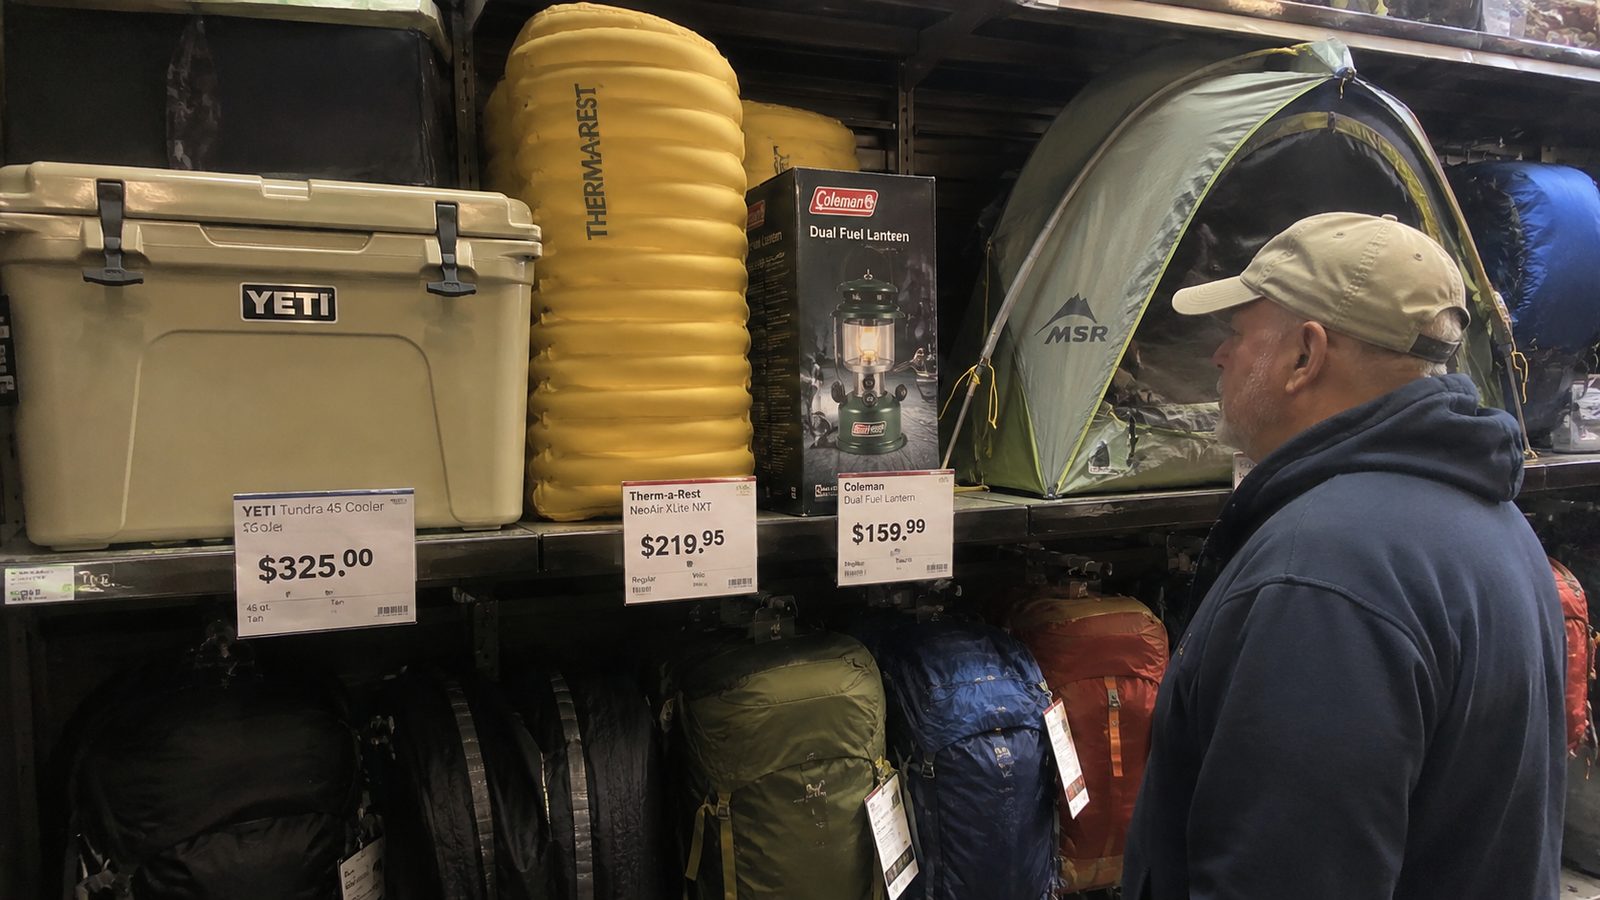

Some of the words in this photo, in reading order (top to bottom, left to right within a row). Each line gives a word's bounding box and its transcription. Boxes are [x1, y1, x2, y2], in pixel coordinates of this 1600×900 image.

[816, 190, 863, 208] Coleman
[809, 225, 837, 239] Dual
[839, 227, 864, 240] Fuel
[246, 290, 329, 316] YETI
[1044, 325, 1109, 345] MSR
[629, 489, 701, 501] Therm-a-Rest
[844, 482, 885, 492] Coleman
[844, 495, 863, 505] Dual
[865, 494, 882, 504] Fuel
[885, 493, 916, 503] Lantern
[242, 505, 276, 517] YETI
[280, 503, 324, 516] Tundra
[327, 502, 342, 513] 45
[345, 501, 385, 513] Cooler
[630, 504, 663, 515] NeoAir
[665, 503, 690, 514] XLite
[692, 502, 712, 512] NXT
[852, 518, 926, 545] $159.99
[641, 529, 725, 559] $219.95
[258, 548, 374, 584] $325.00
